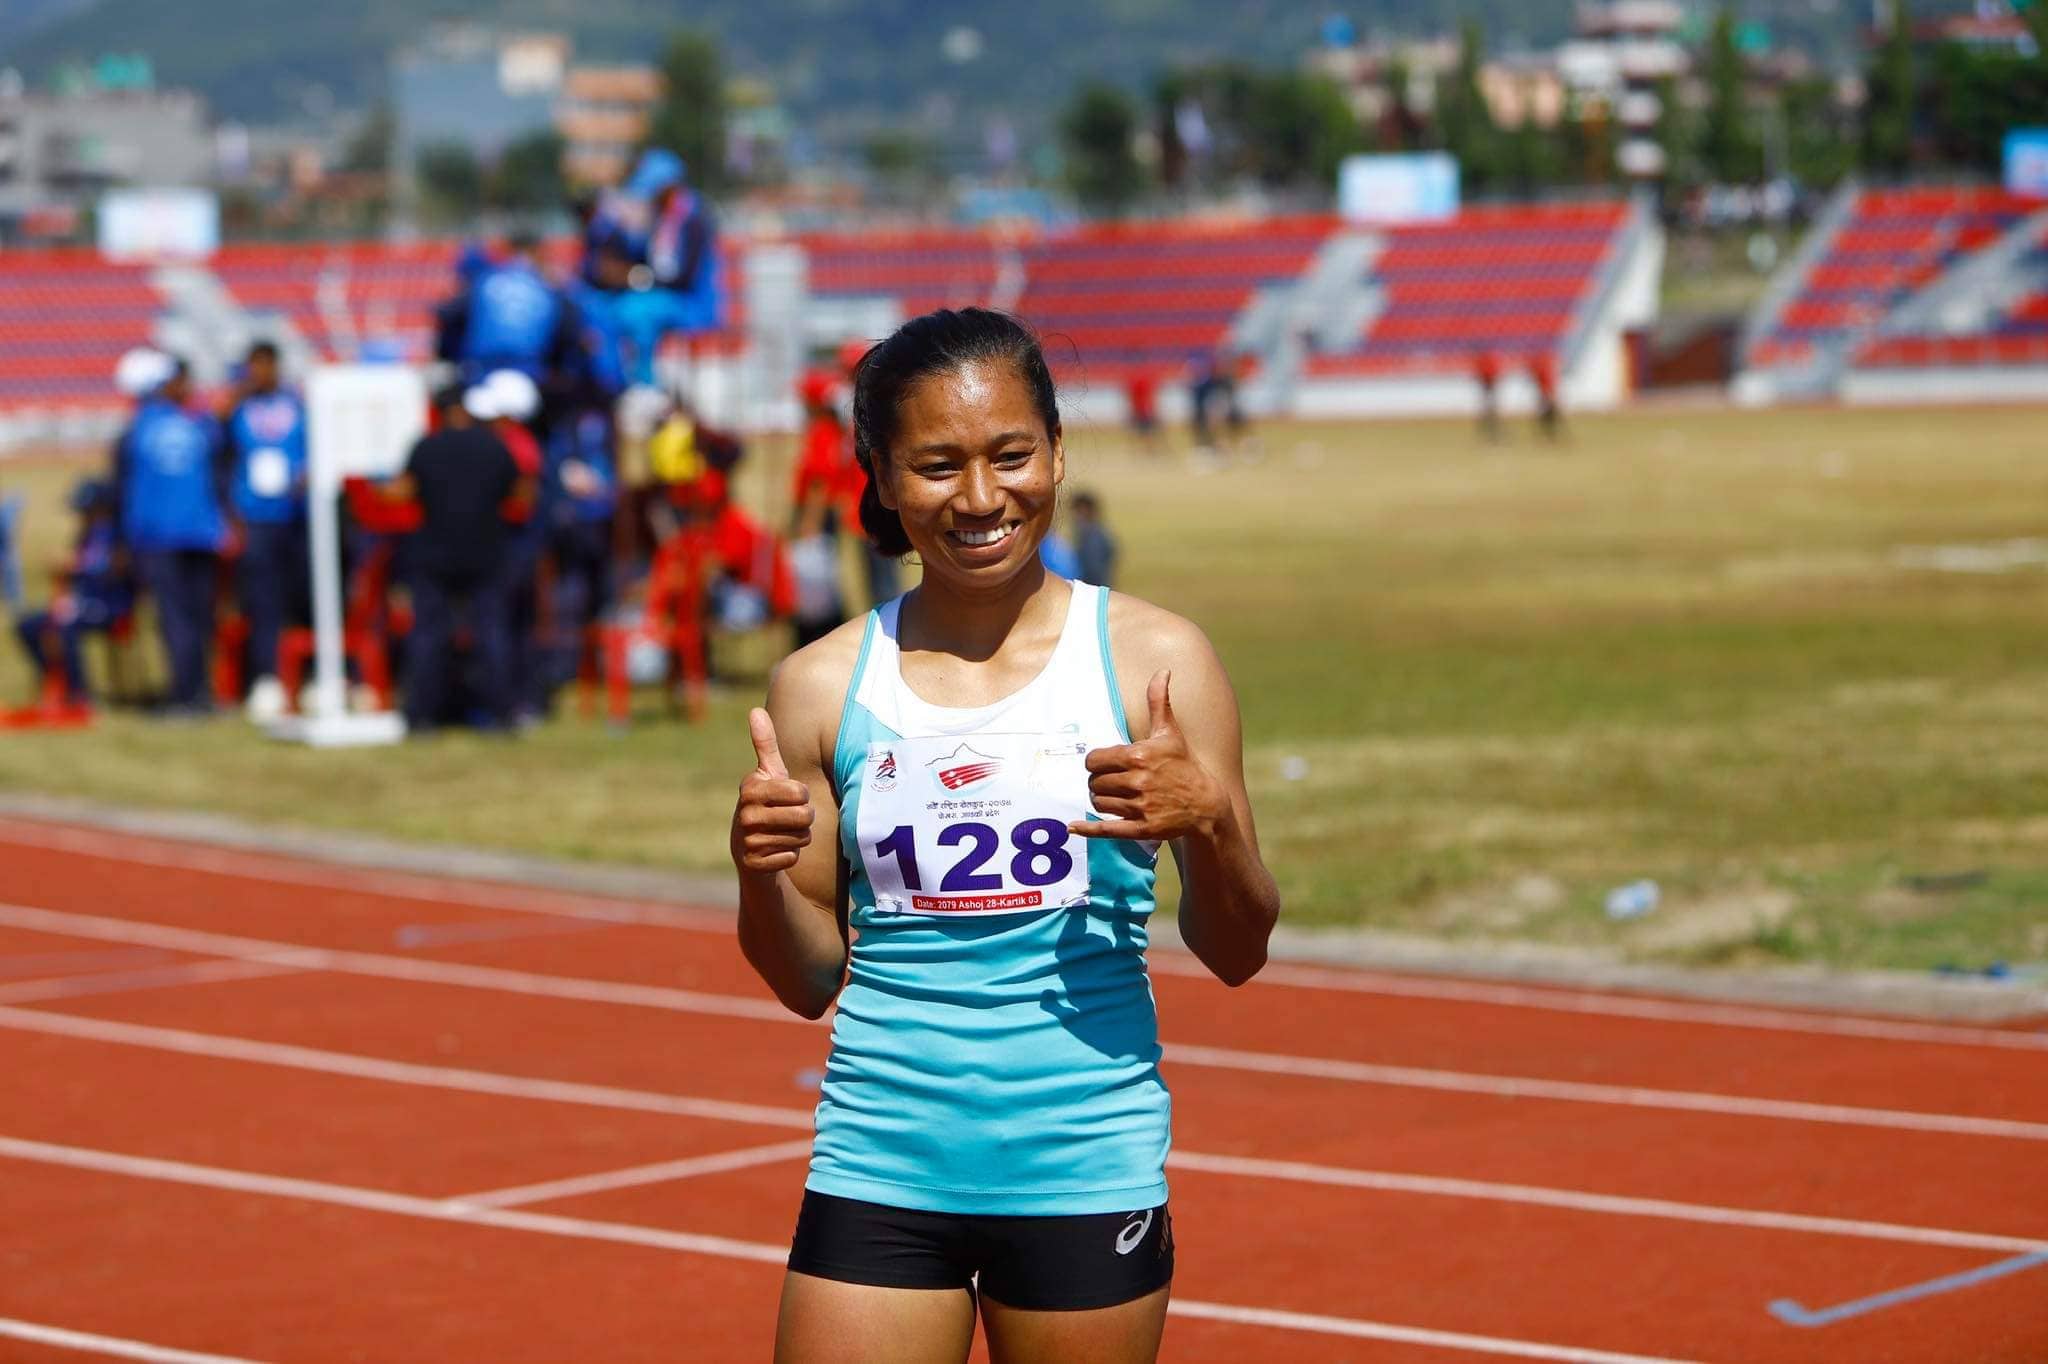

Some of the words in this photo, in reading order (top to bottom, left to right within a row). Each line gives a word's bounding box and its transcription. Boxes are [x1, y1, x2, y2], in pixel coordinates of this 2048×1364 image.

[875, 818, 1073, 892] 128
[917, 898, 936, 908] Date:
[938, 900, 957, 909] 2079
[959, 899, 984, 911] Ashoj
[986, 896, 1026, 908] 28-Kartik
[1028, 895, 1039, 905] 03
